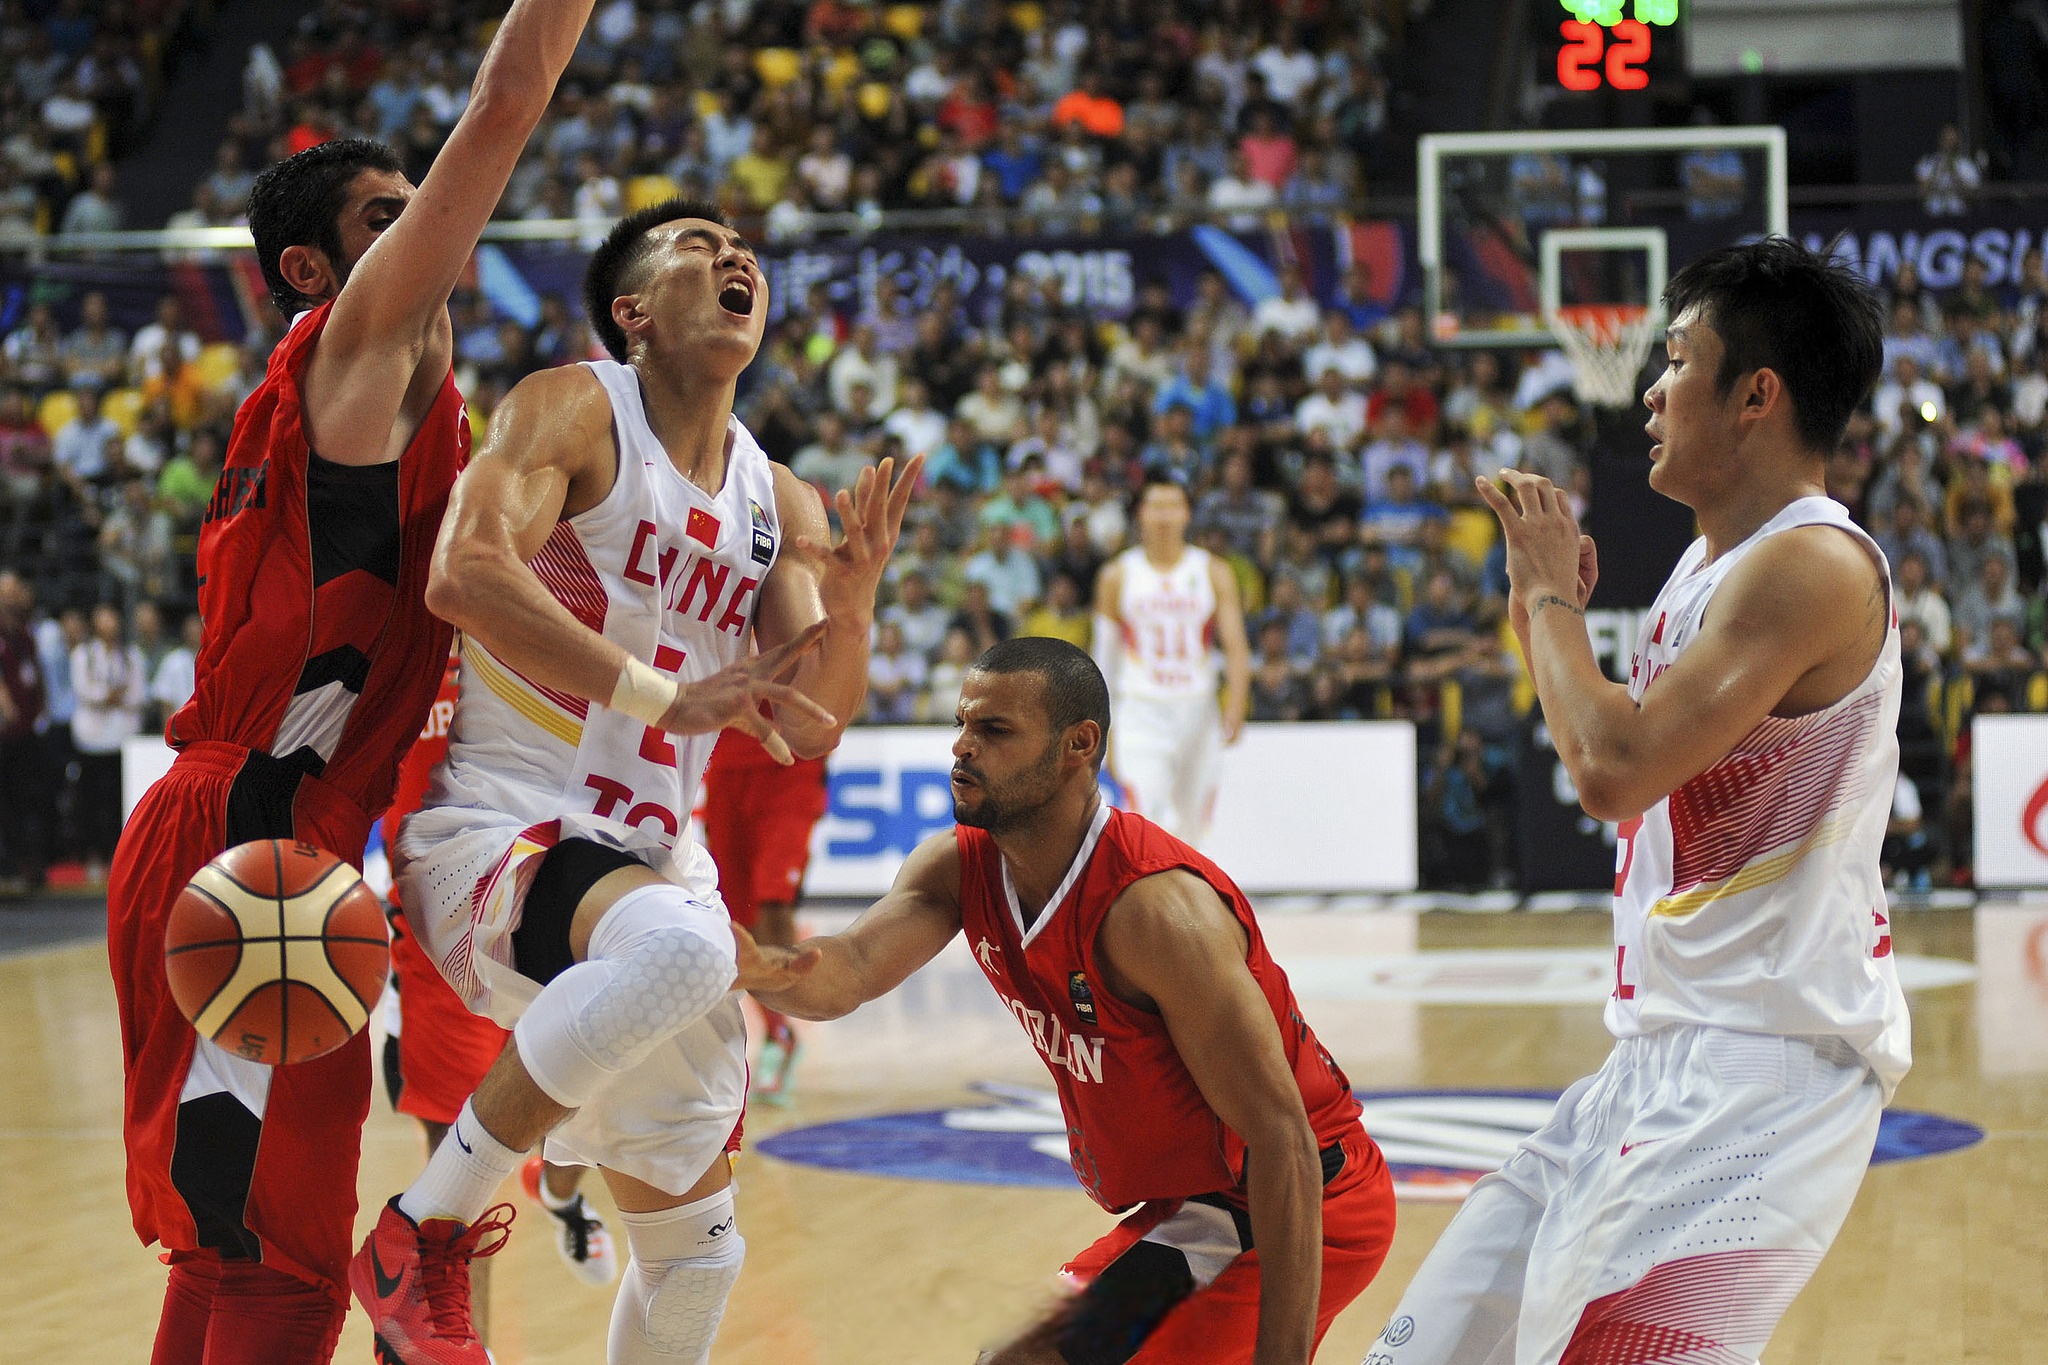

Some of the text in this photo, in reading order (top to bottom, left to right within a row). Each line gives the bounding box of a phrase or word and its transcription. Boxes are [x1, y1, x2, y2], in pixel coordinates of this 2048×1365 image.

[1557, 19, 1652, 91] 22
[755, 533, 772, 550] FIBA
[1075, 1002, 1093, 1013] FIBA
